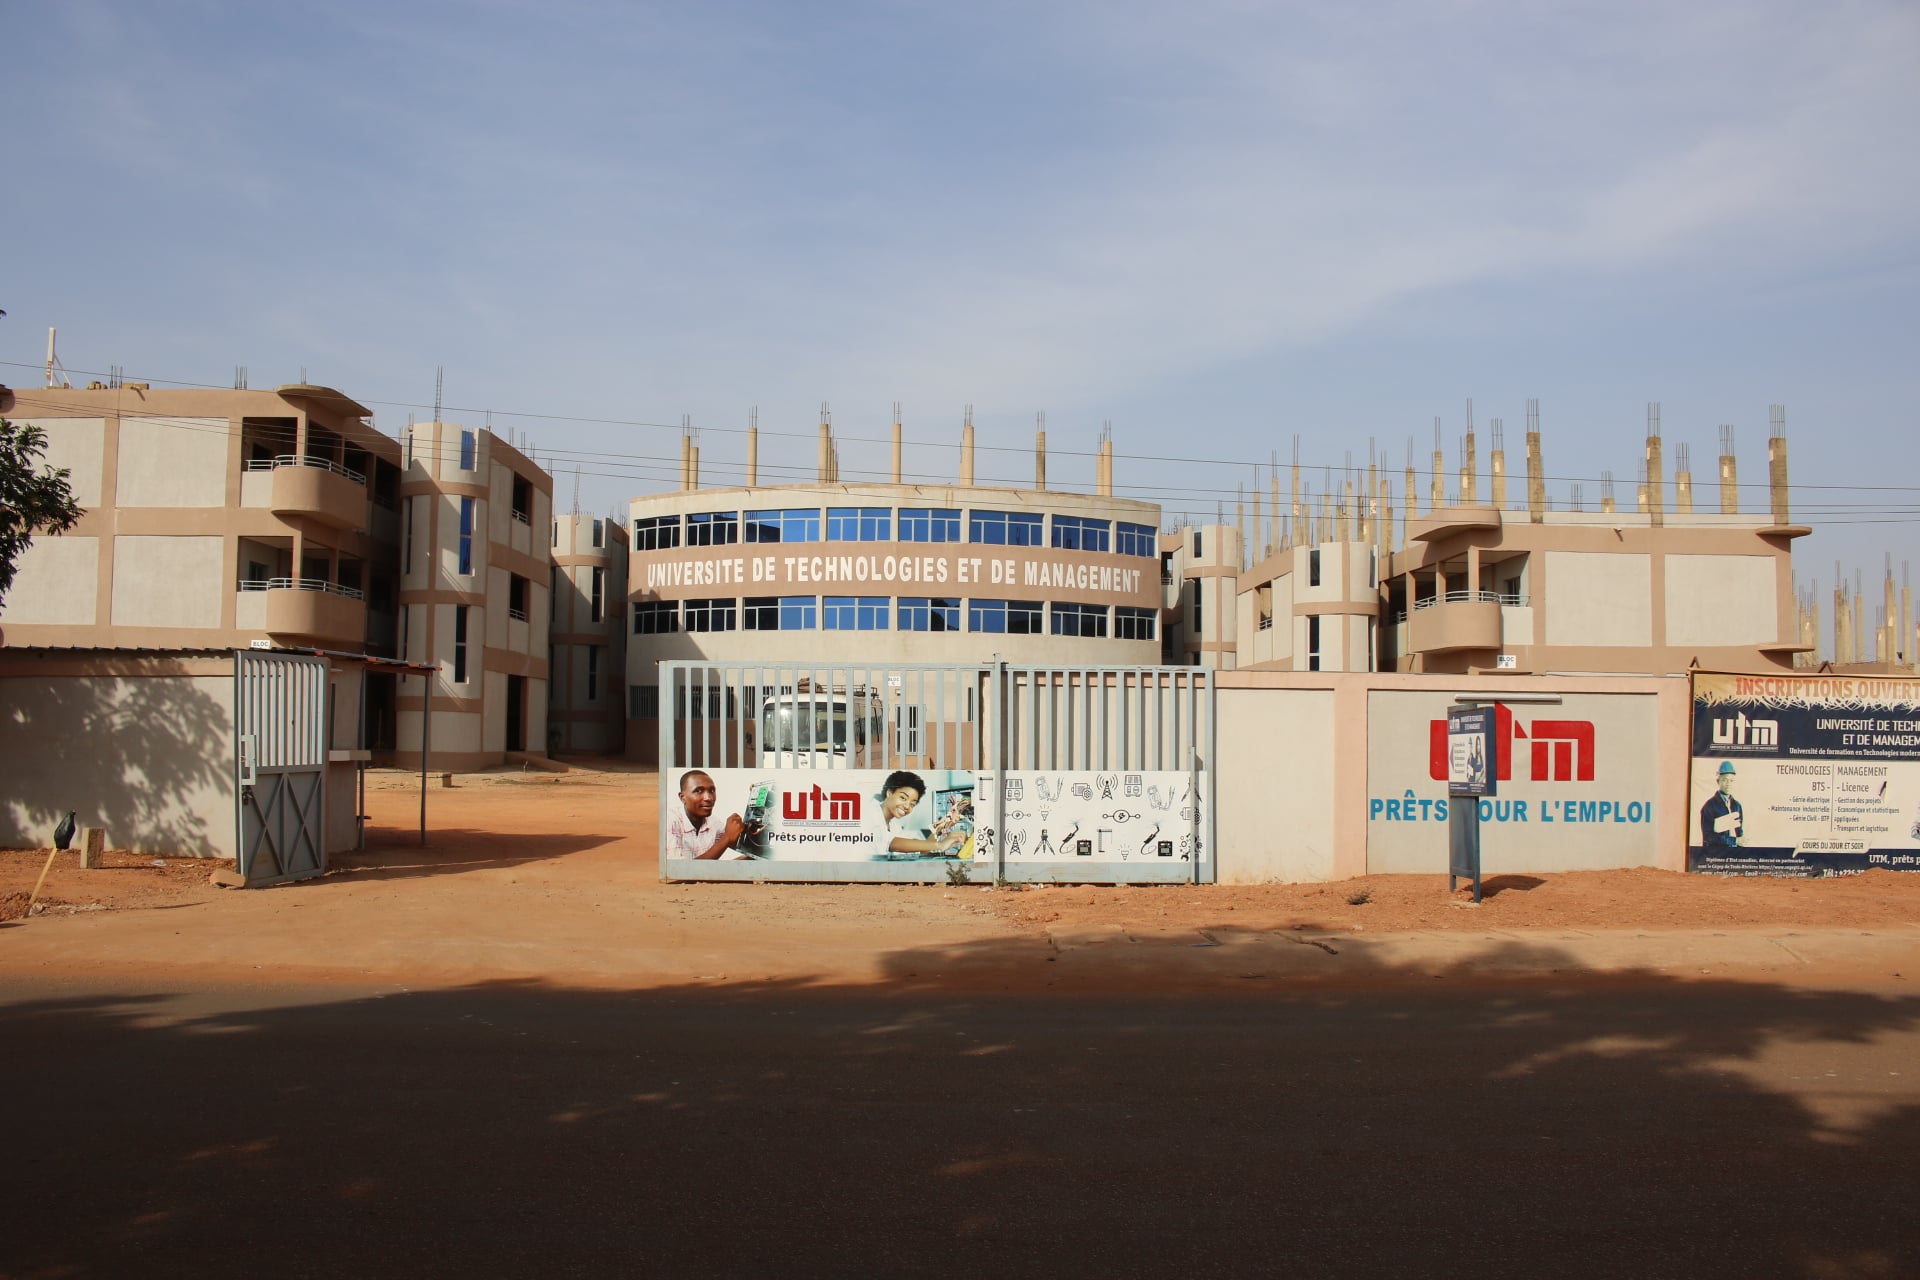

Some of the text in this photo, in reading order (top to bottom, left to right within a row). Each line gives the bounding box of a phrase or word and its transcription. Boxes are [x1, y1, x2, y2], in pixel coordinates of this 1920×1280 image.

[648, 556, 1140, 593] UNIVERSITE DE TECHNOLOGIES ET DE MANAGEMENT
[1735, 678, 1853, 698] INSCRIPTIONS
[1712, 711, 1778, 745] utm
[1816, 718, 1874, 731] UNIVERSITÉ
[1876, 720, 1890, 731] DE
[1842, 734, 1855, 745] ET
[1857, 734, 1870, 746] DE
[1789, 747, 1817, 755] Université
[1827, 748, 1854, 756] formation
[1863, 749, 1899, 757] Technologies
[1776, 764, 1831, 776] TECHNOLOGIES
[1837, 766, 1888, 777] MANAGEMENT
[1812, 781, 1826, 792] BTS
[1841, 782, 1870, 793] Licence
[782, 783, 861, 820] utm
[1370, 789, 1651, 823] PRÊTS OUR L'EMPLOI
[768, 831, 797, 843] Prêts
[799, 834, 826, 845] pour
[1802, 842, 1819, 850] COURS
[1820, 842, 1828, 850] DU
[1829, 842, 1844, 850] JOUR
[1869, 854, 1890, 864] UTM,
[1892, 854, 1914, 865] prêts
